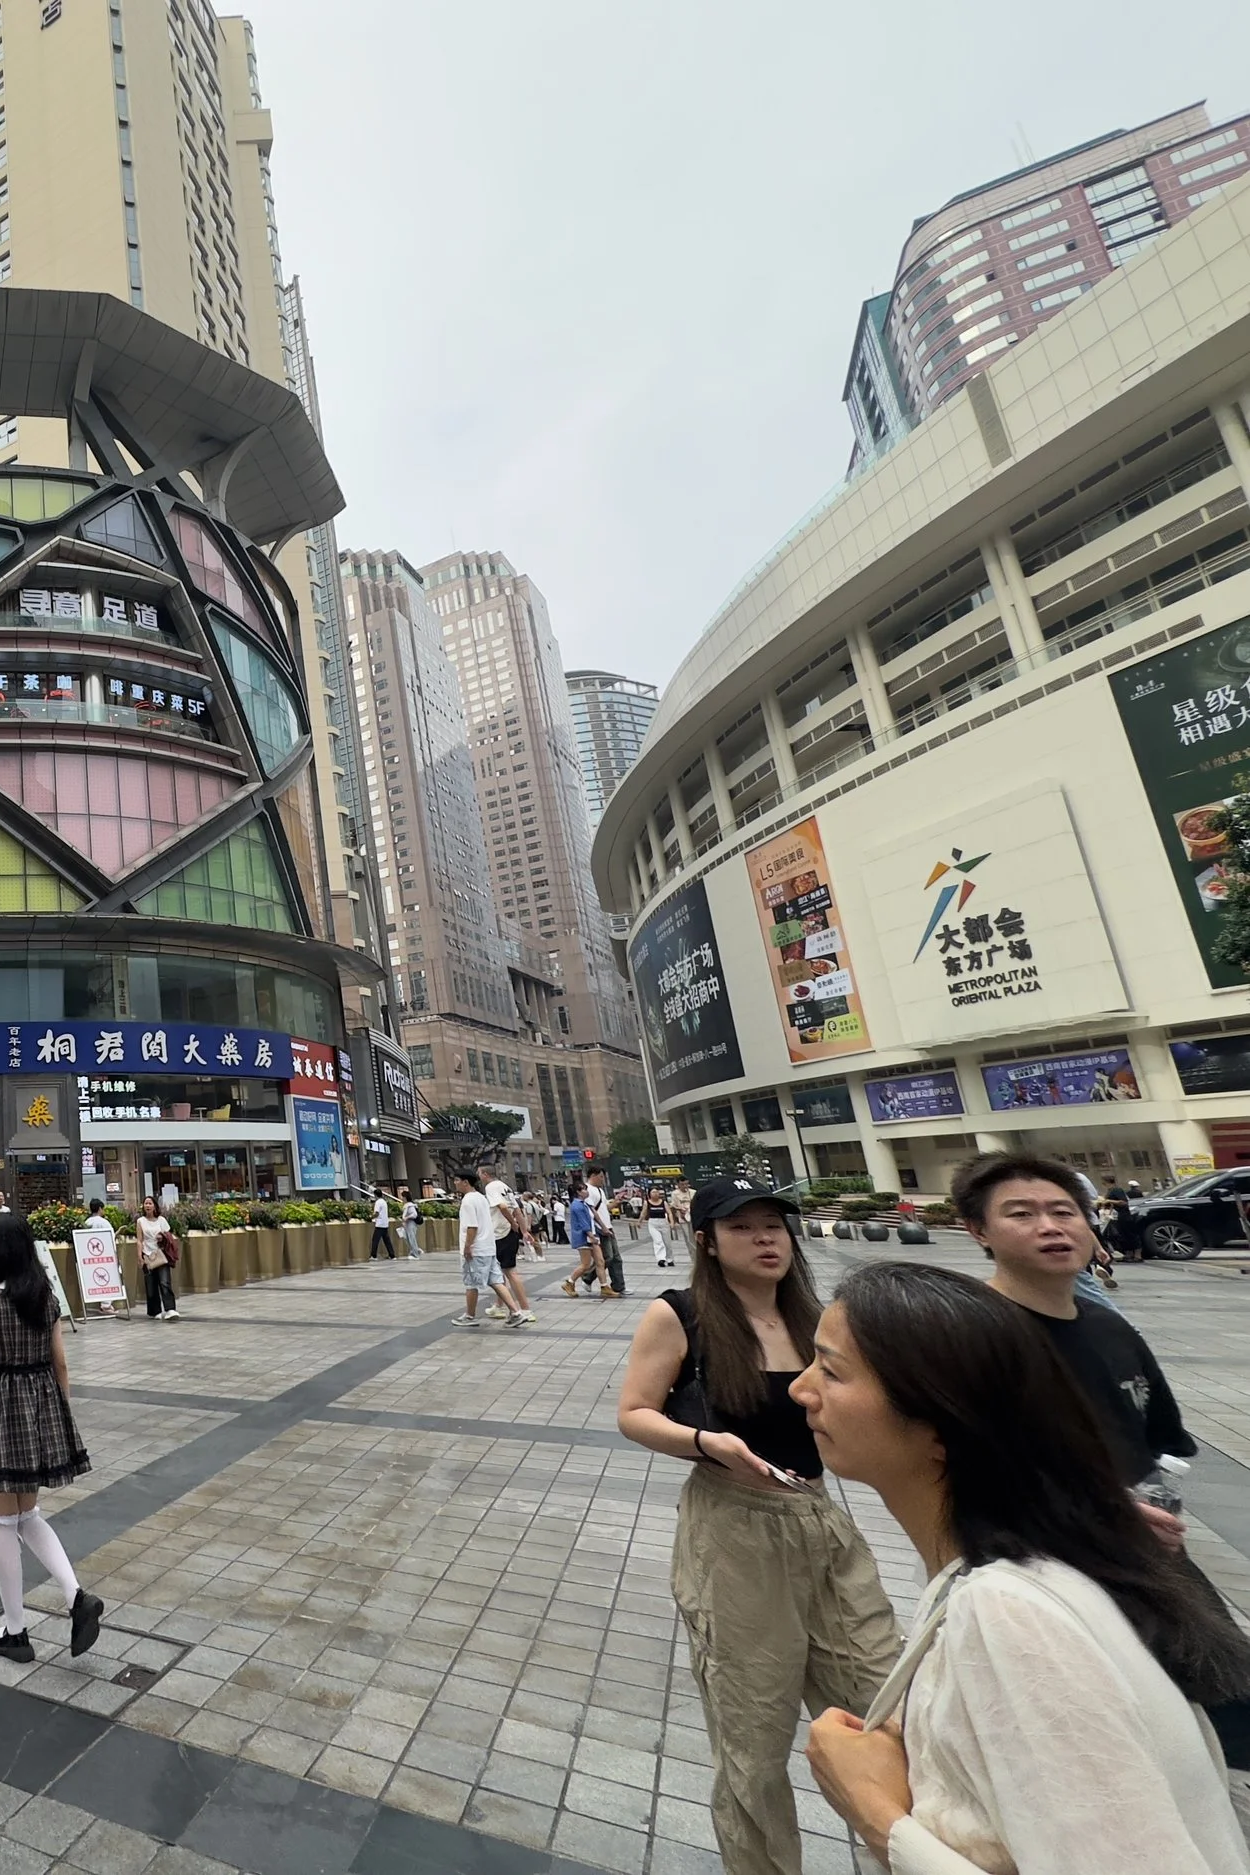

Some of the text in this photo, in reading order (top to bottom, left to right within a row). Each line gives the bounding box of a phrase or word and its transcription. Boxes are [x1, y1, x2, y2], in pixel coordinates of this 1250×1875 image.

[935, 907, 1025, 954] 大都会
[942, 938, 1033, 977] 东方广场
[947, 965, 1038, 995] METROPOLITAN
[951, 980, 1042, 1008] ORIENTAL PLAZA
[8, 1026, 22, 1068] 百年老店
[91, 1080, 137, 1093] 手机维修
